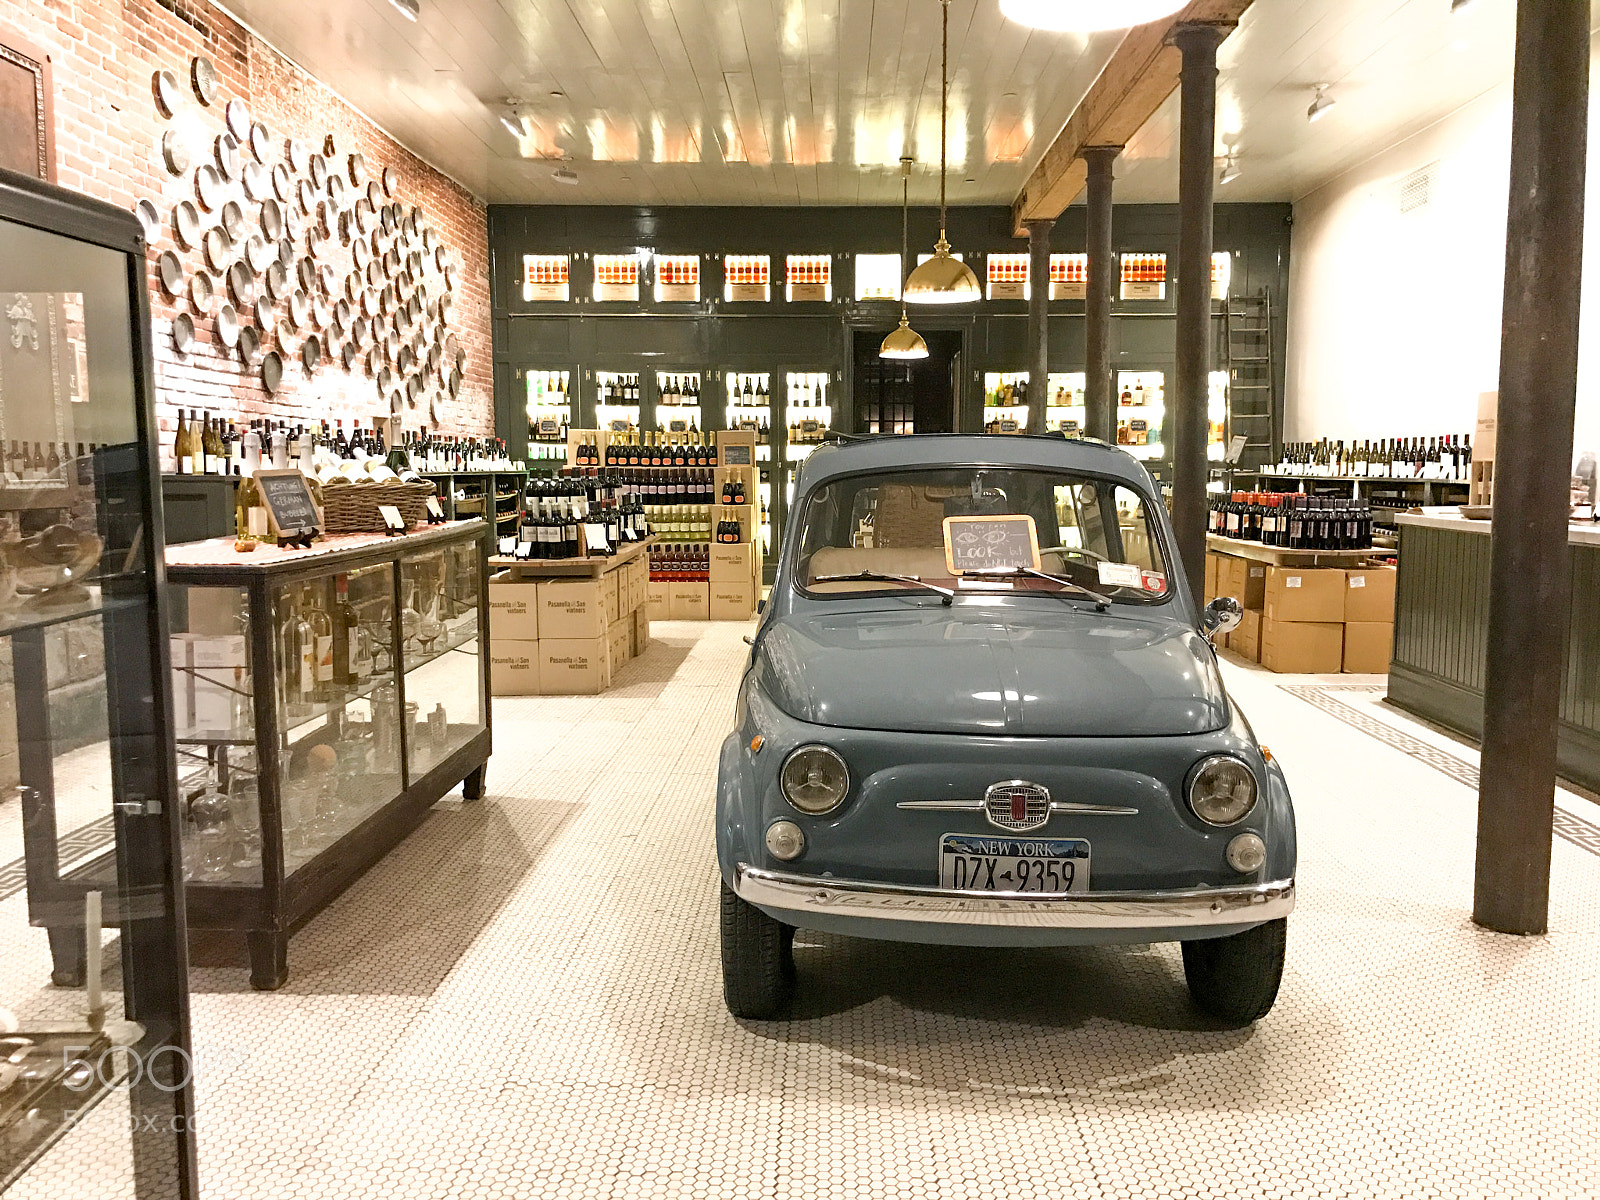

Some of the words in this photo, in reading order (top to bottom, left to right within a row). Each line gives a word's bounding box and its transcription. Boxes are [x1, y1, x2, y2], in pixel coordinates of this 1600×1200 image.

[956, 546, 1002, 558] LOOK
[547, 600, 571, 608] Pasanella
[549, 656, 573, 664] Pasanella
[978, 840, 1012, 854] NEW
[1016, 842, 1056, 857] YORK
[1016, 859, 1075, 892] 9359
